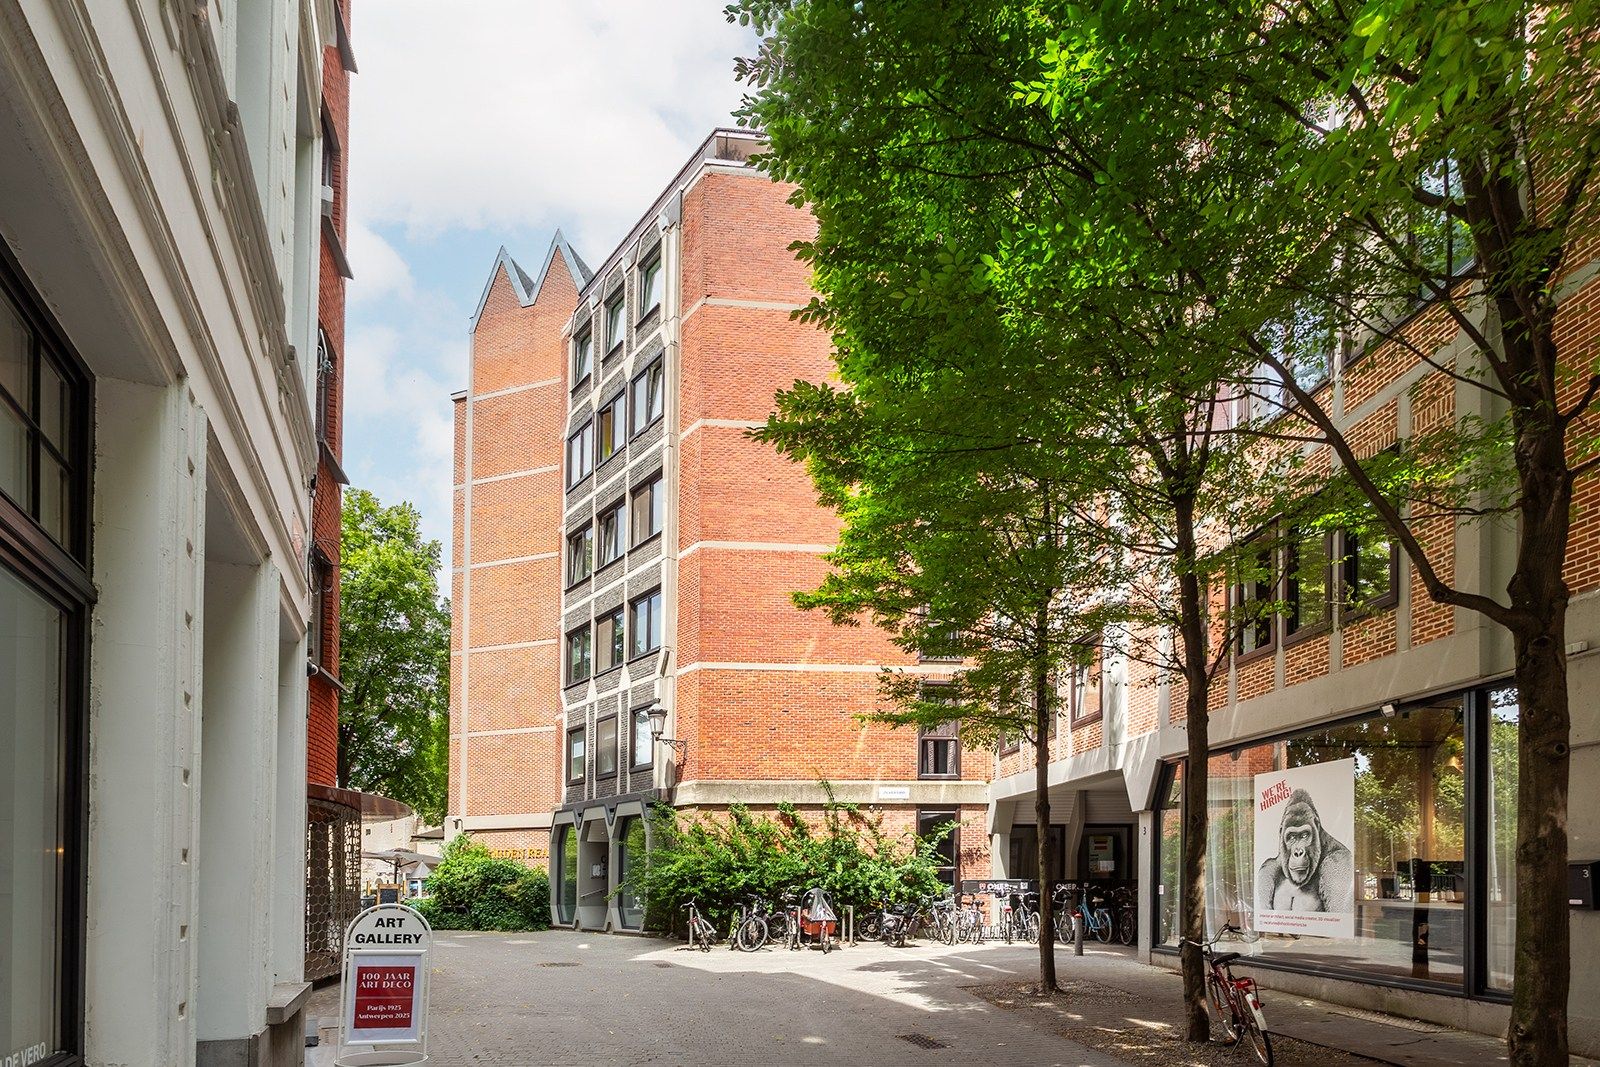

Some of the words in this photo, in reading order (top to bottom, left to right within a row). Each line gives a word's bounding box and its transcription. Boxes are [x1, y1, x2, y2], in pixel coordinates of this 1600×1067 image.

[1261, 779, 1288, 800] WE'RE
[1260, 787, 1293, 811] HIRING!
[1582, 869, 1589, 878] 3
[375, 917, 406, 928] ART
[355, 933, 422, 944] GALLERY
[362, 972, 381, 980] 100
[384, 972, 410, 980] JAAR
[367, 1004, 386, 1012] Parijs
[21, 1041, 46, 1067] VERO
